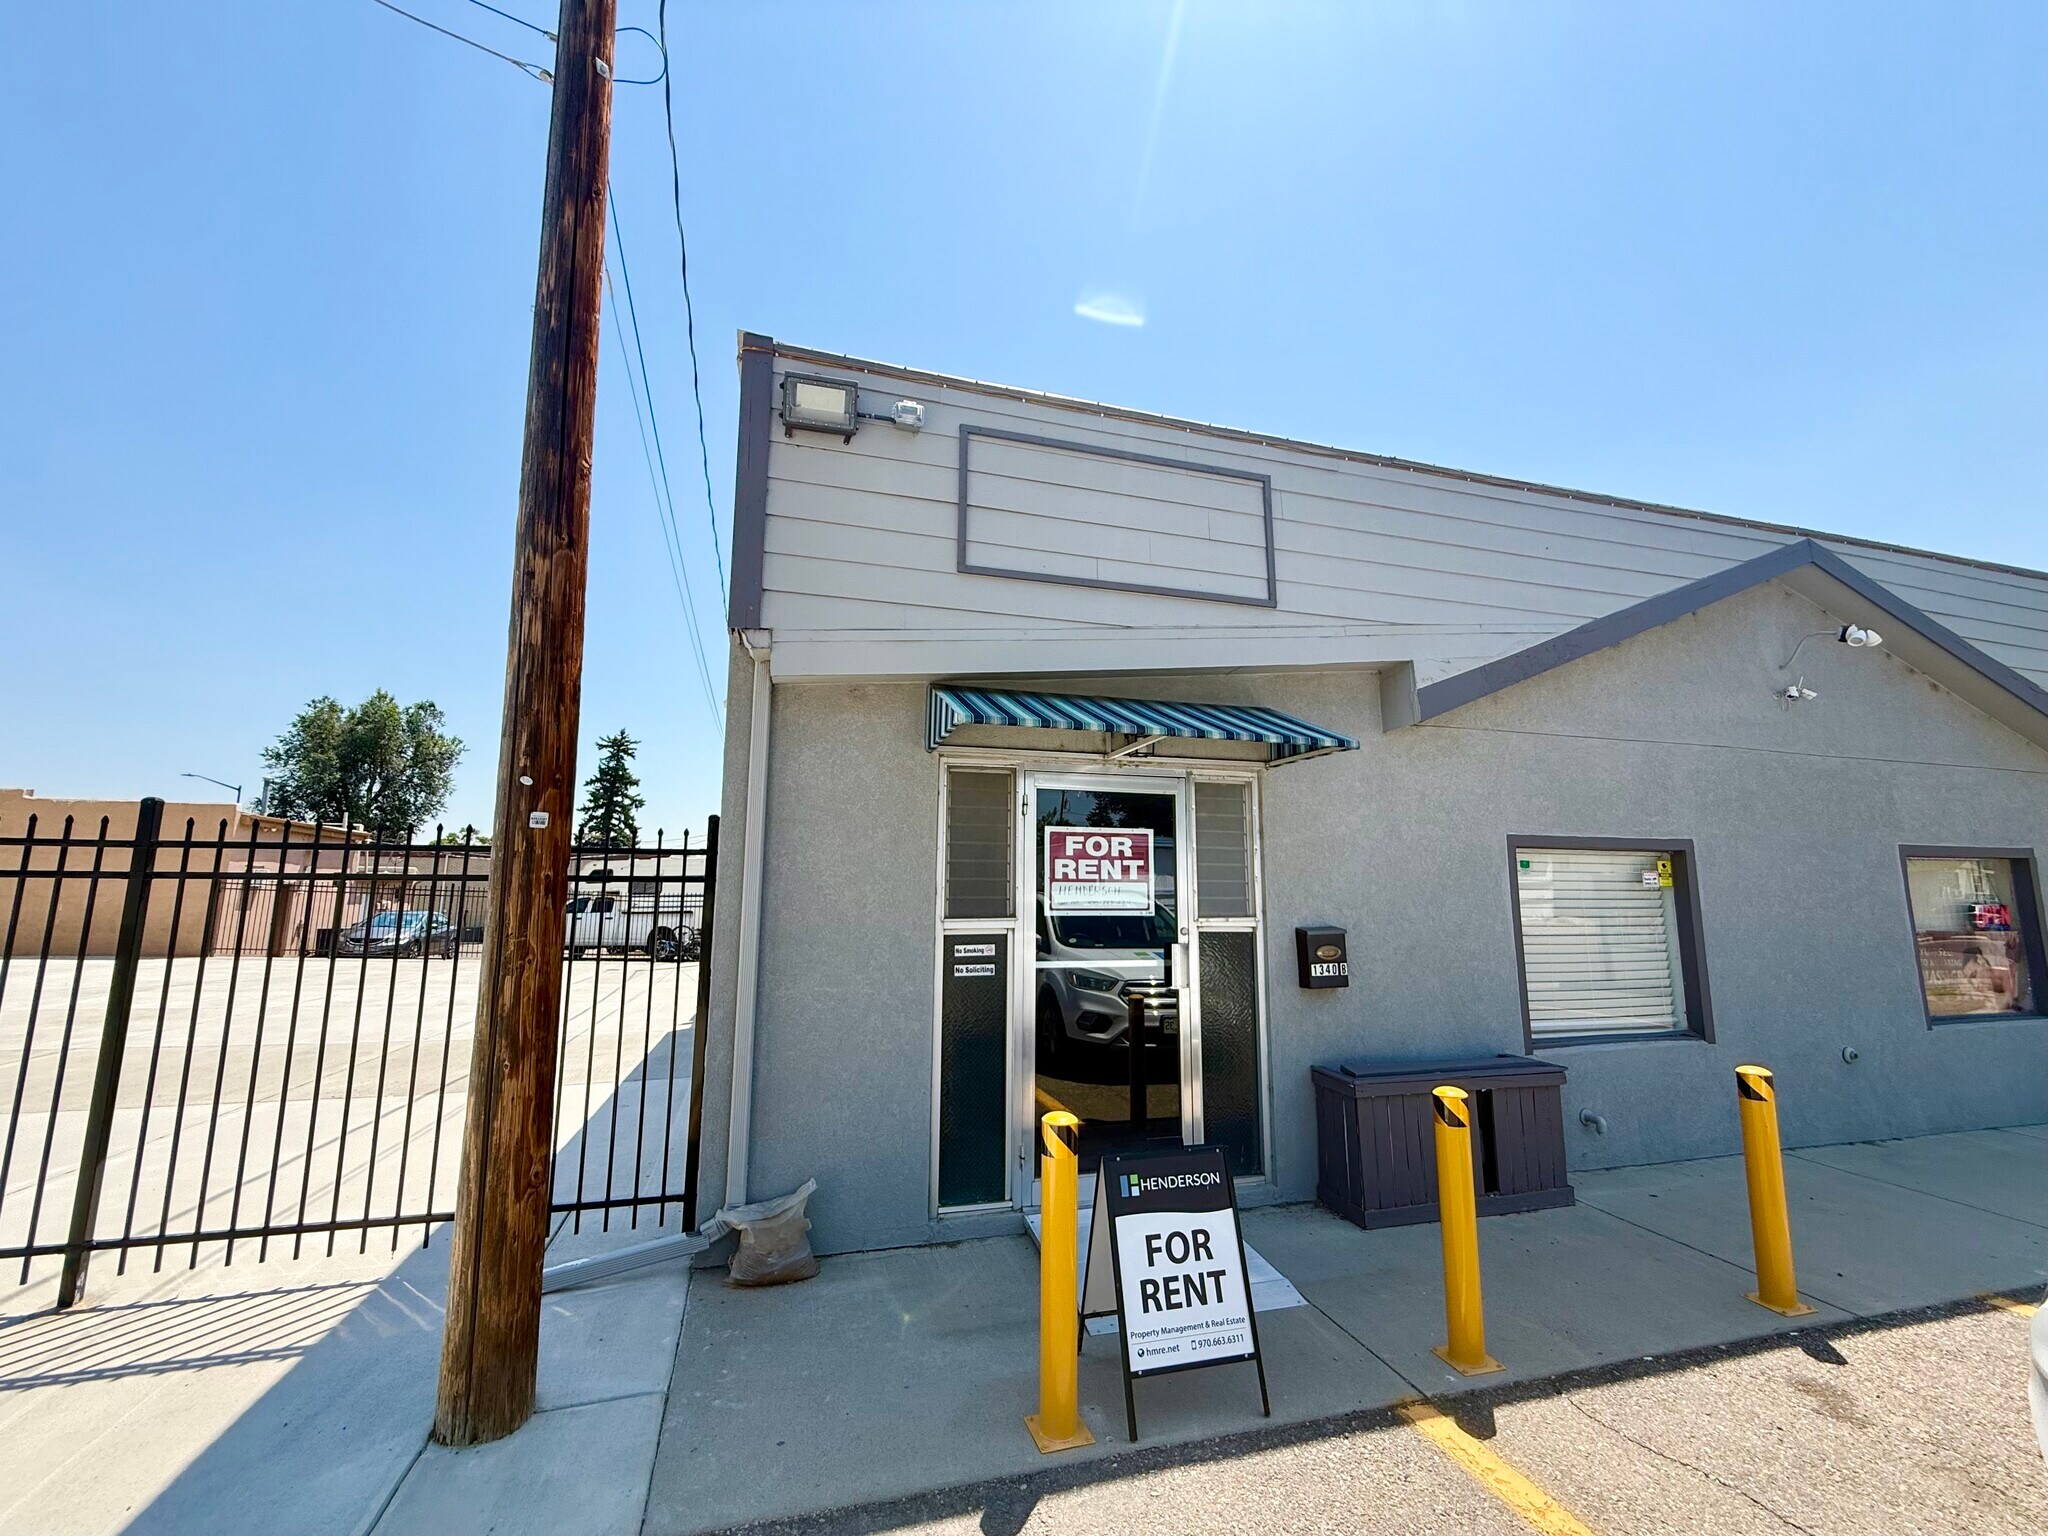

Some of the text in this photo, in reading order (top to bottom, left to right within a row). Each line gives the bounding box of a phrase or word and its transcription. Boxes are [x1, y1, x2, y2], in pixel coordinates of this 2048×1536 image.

[1065, 835, 1133, 857] FOR
[1054, 858, 1145, 880] RENT
[963, 946, 985, 954] Smoking
[955, 965, 994, 975] No Soliciting
[1313, 964, 1337, 976] 1340
[1140, 1172, 1221, 1191] HENDERSON
[1145, 1228, 1214, 1268] FOR
[1140, 1269, 1227, 1314] RENT
[1130, 1316, 1246, 1340] Property Management & Real Estate
[1146, 1333, 1245, 1357] hmre.net 970.663.6311
